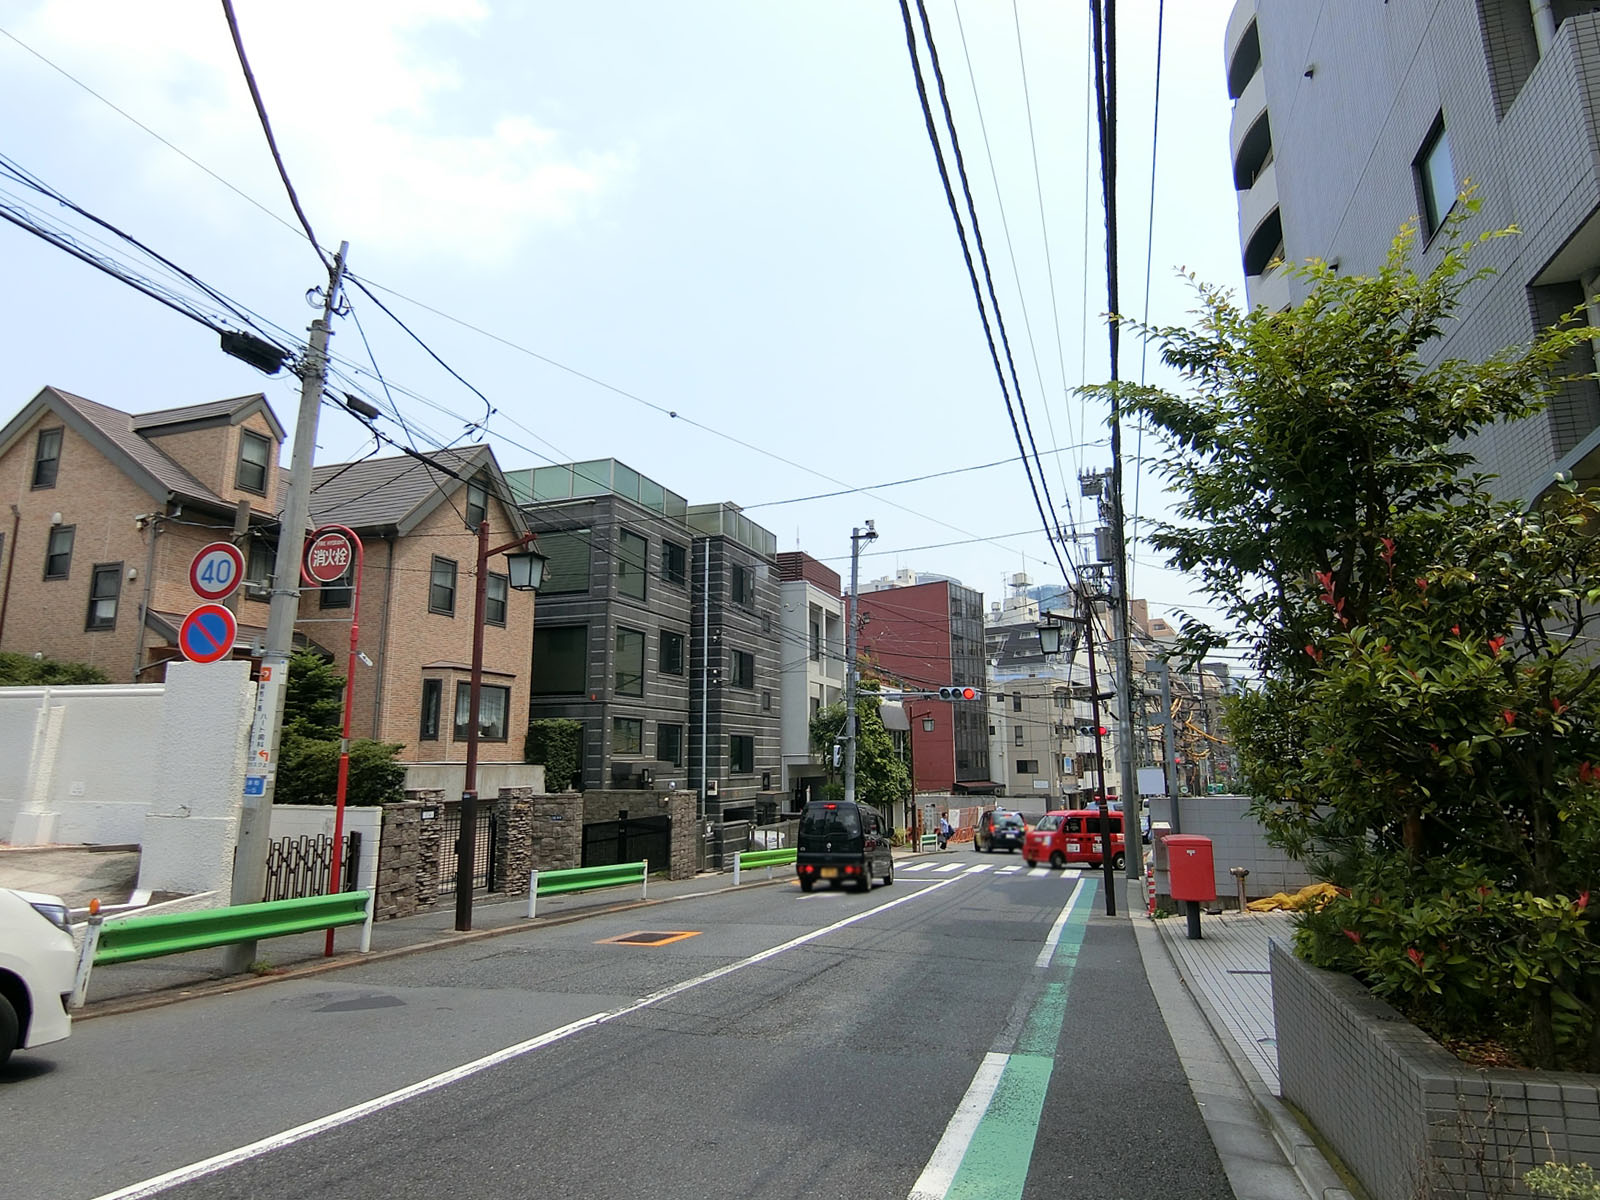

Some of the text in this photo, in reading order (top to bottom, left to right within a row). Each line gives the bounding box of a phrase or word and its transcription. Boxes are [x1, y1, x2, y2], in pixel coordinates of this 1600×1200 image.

[313, 547, 348, 567] 消火栓
[201, 559, 232, 584] 40
